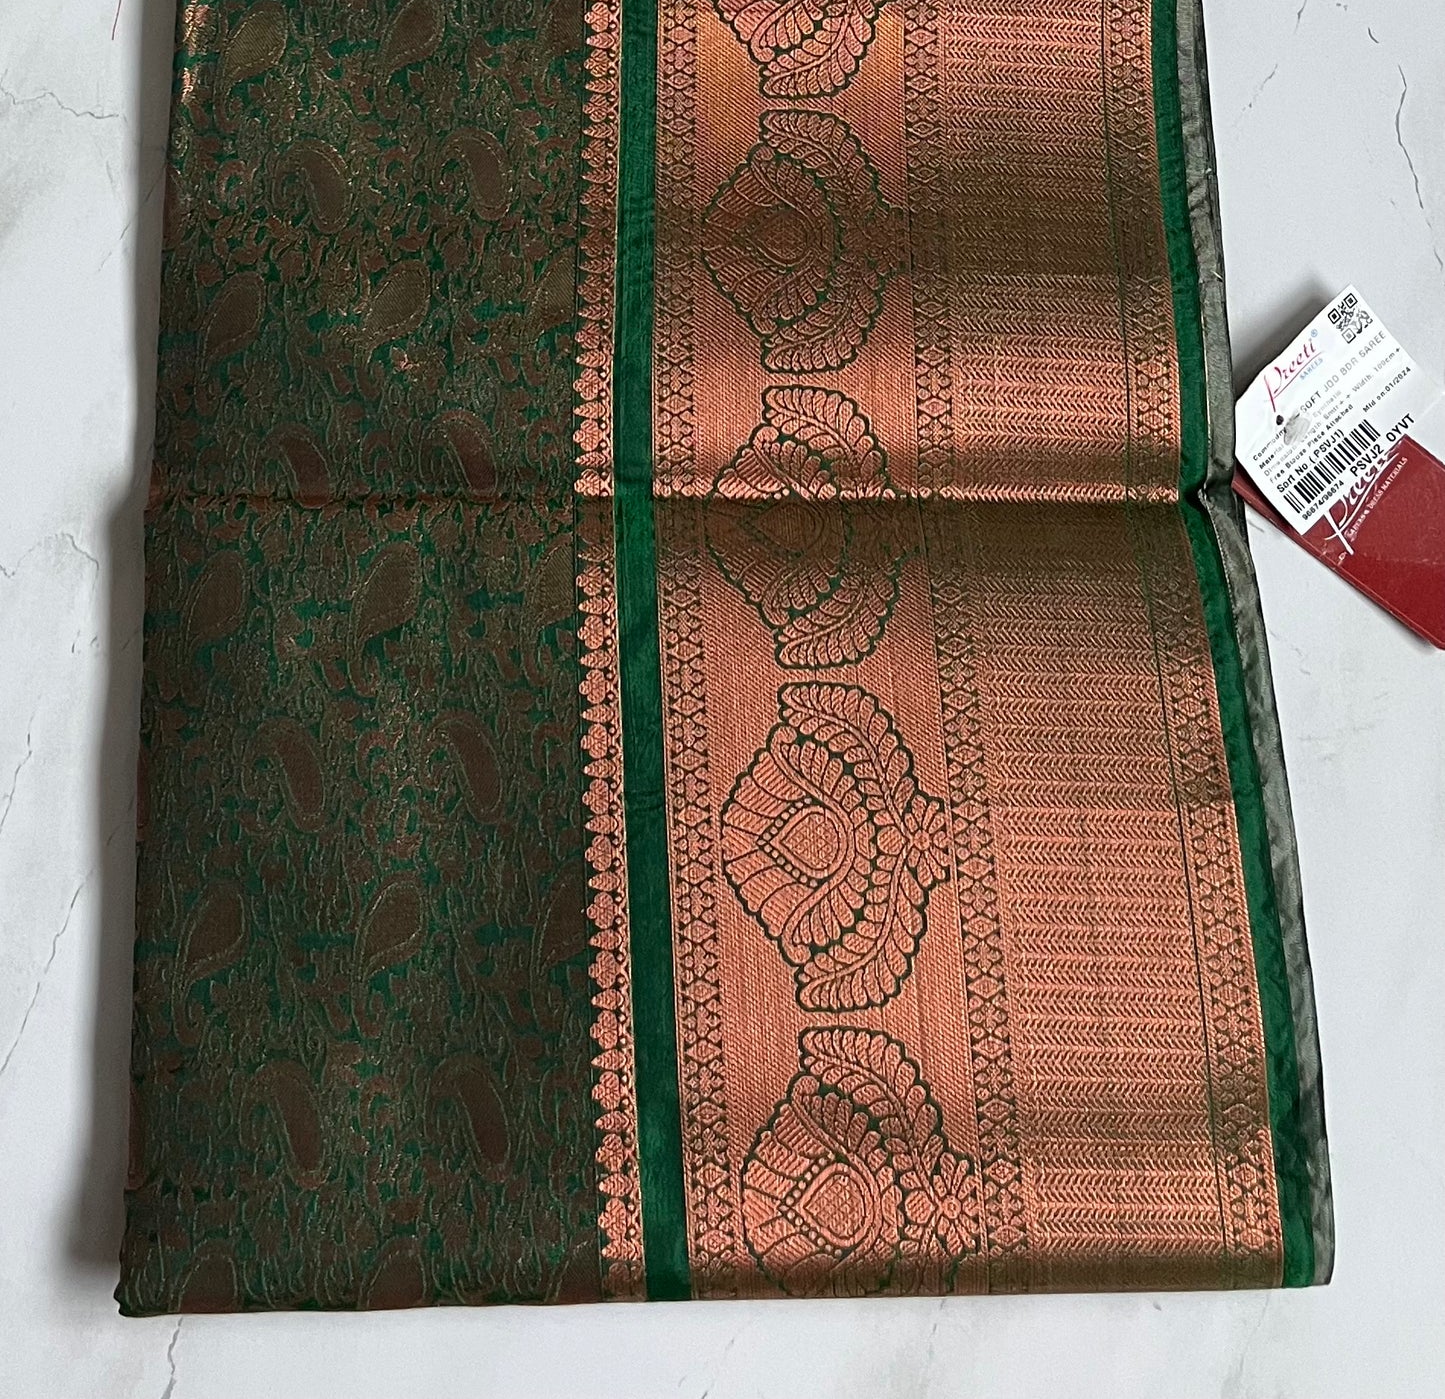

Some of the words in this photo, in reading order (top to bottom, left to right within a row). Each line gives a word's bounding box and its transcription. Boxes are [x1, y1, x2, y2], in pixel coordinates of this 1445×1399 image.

[1299, 390, 1321, 412] SOFT
[1358, 330, 1385, 357] SAREE
[1349, 443, 1384, 477] PSVJ2
[1276, 474, 1295, 493] Sort
